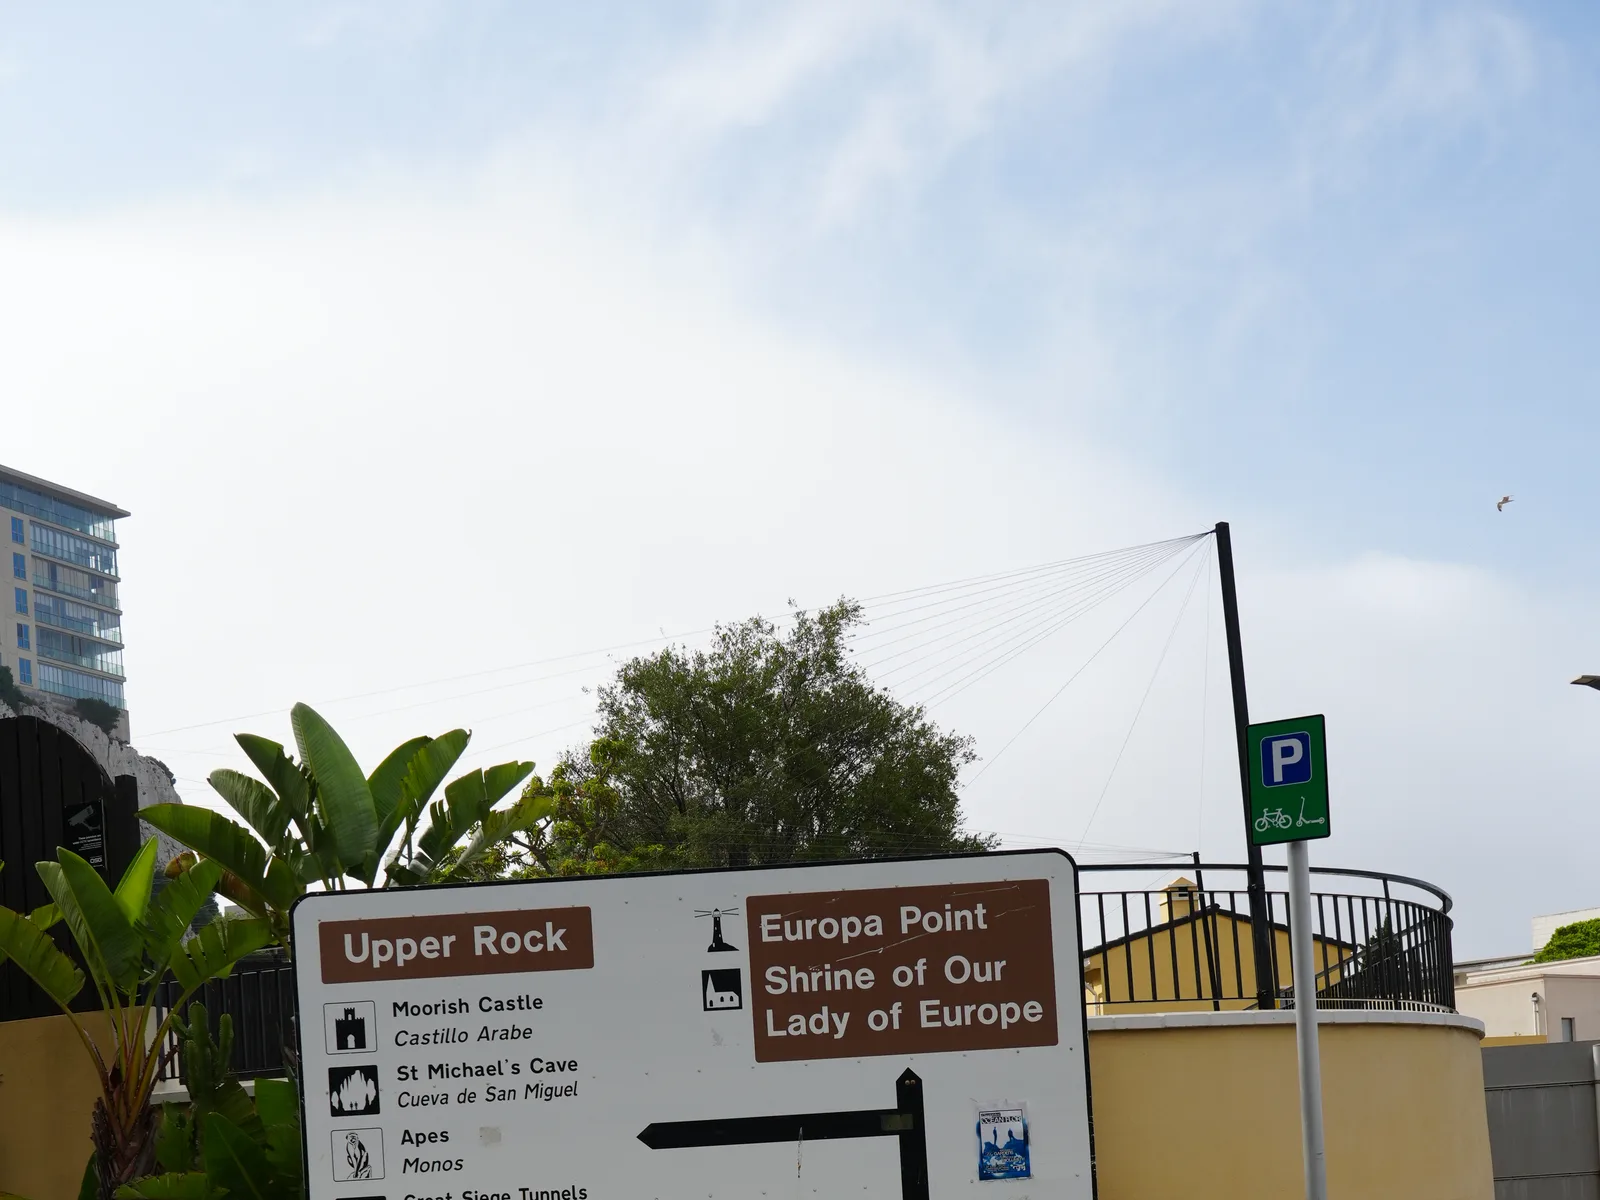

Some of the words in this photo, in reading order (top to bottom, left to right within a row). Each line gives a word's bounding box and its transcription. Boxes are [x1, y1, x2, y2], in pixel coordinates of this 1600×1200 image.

[1272, 738, 1303, 782] P
[760, 912, 883, 943] Europa
[900, 903, 988, 934] Point
[344, 932, 456, 968] Upper
[473, 921, 567, 956] Rock
[764, 964, 875, 995] Shrine
[892, 958, 927, 987] of
[944, 955, 1006, 985] Our
[393, 998, 470, 1018] Moorish
[479, 995, 544, 1013] Castle
[766, 1006, 850, 1039] Lady
[868, 1002, 902, 1031] of
[920, 998, 1043, 1030] Europe
[394, 1026, 469, 1047] Castillo
[477, 1024, 533, 1043] Arabe
[397, 1064, 419, 1082] St
[428, 1058, 521, 1080] Michael's
[530, 1056, 578, 1074] Cave
[398, 1090, 450, 1108] Cueva
[456, 1087, 477, 1105] de
[485, 1085, 517, 1103] San
[524, 1081, 578, 1104] Miguel
[400, 1128, 450, 1148] Apes
[402, 1156, 464, 1174] Monos
